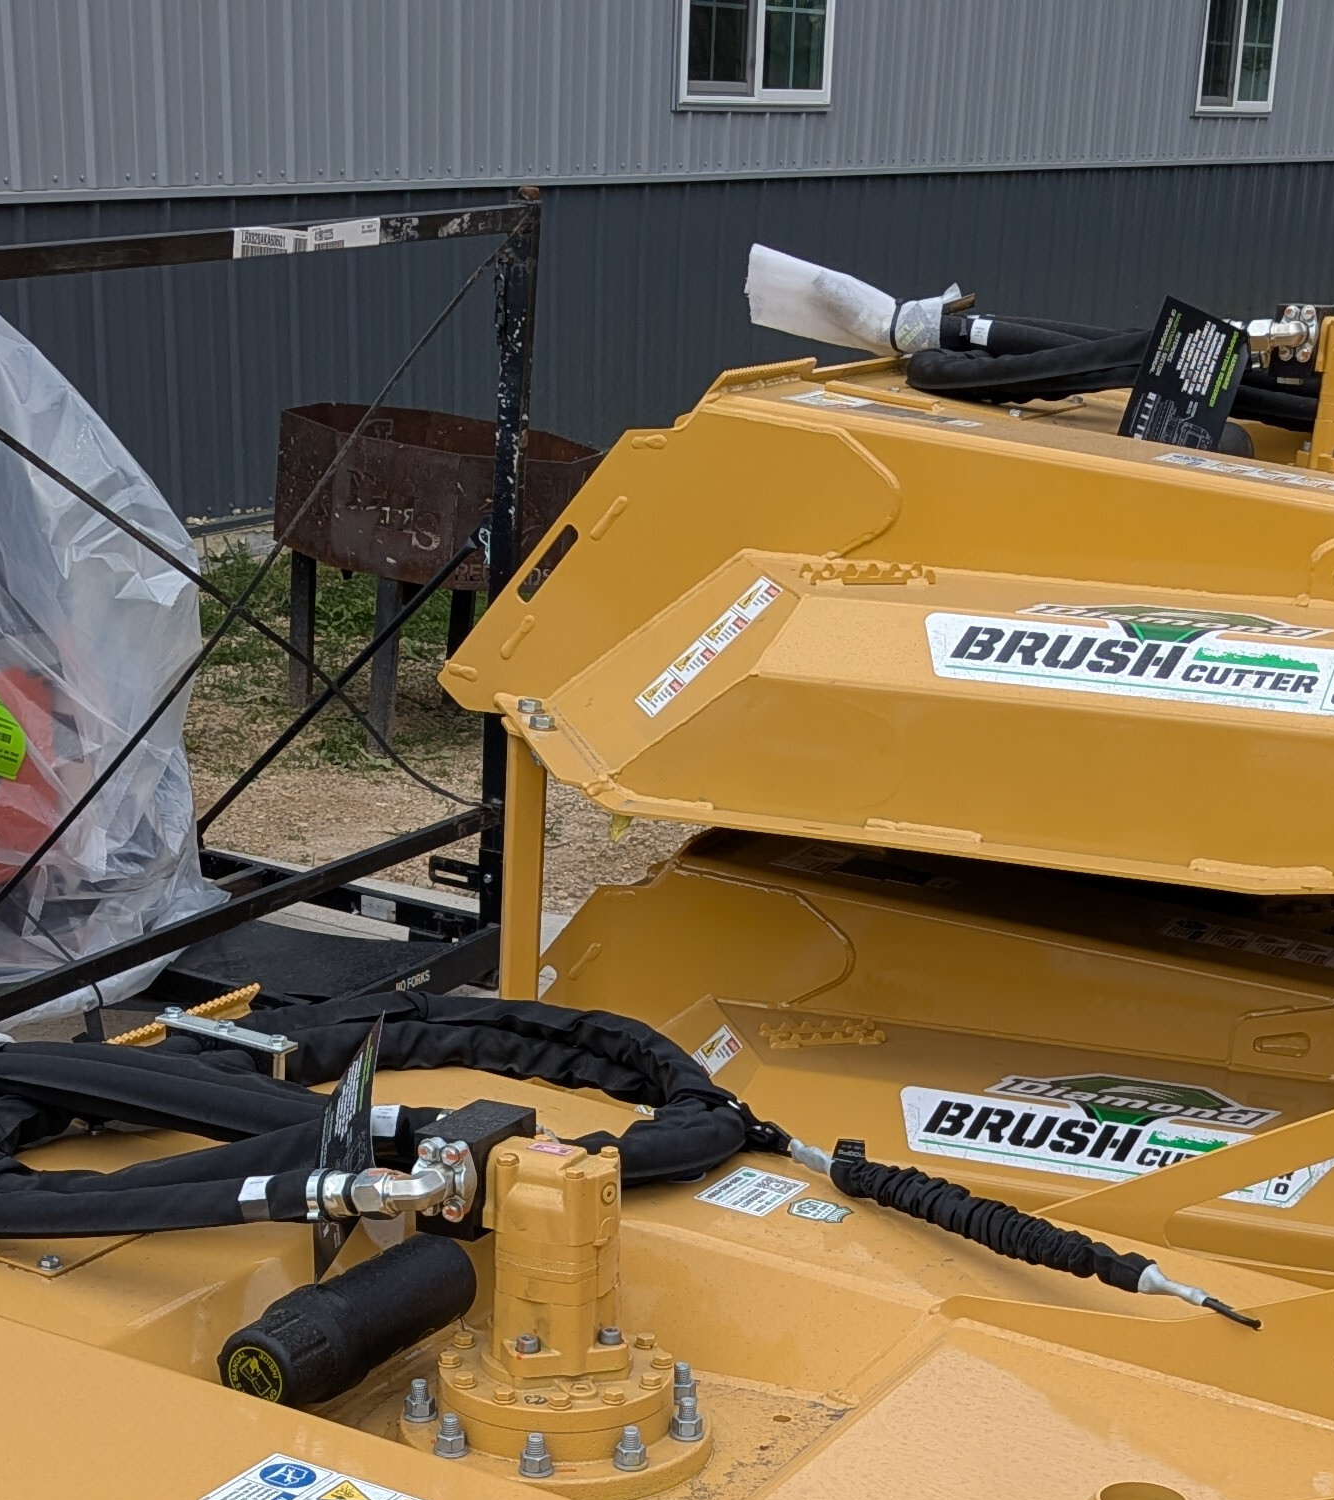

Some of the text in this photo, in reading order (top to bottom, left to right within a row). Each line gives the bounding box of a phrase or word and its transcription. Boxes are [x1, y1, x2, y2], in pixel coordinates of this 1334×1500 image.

[1040, 605, 1312, 638] Diamond
[950, 626, 1189, 680] BRUSH
[1181, 664, 1319, 694] CUTTER
[407, 970, 431, 989] FORKS
[1007, 1078, 1263, 1125] Diamond
[923, 1100, 1144, 1164] BRUSH
